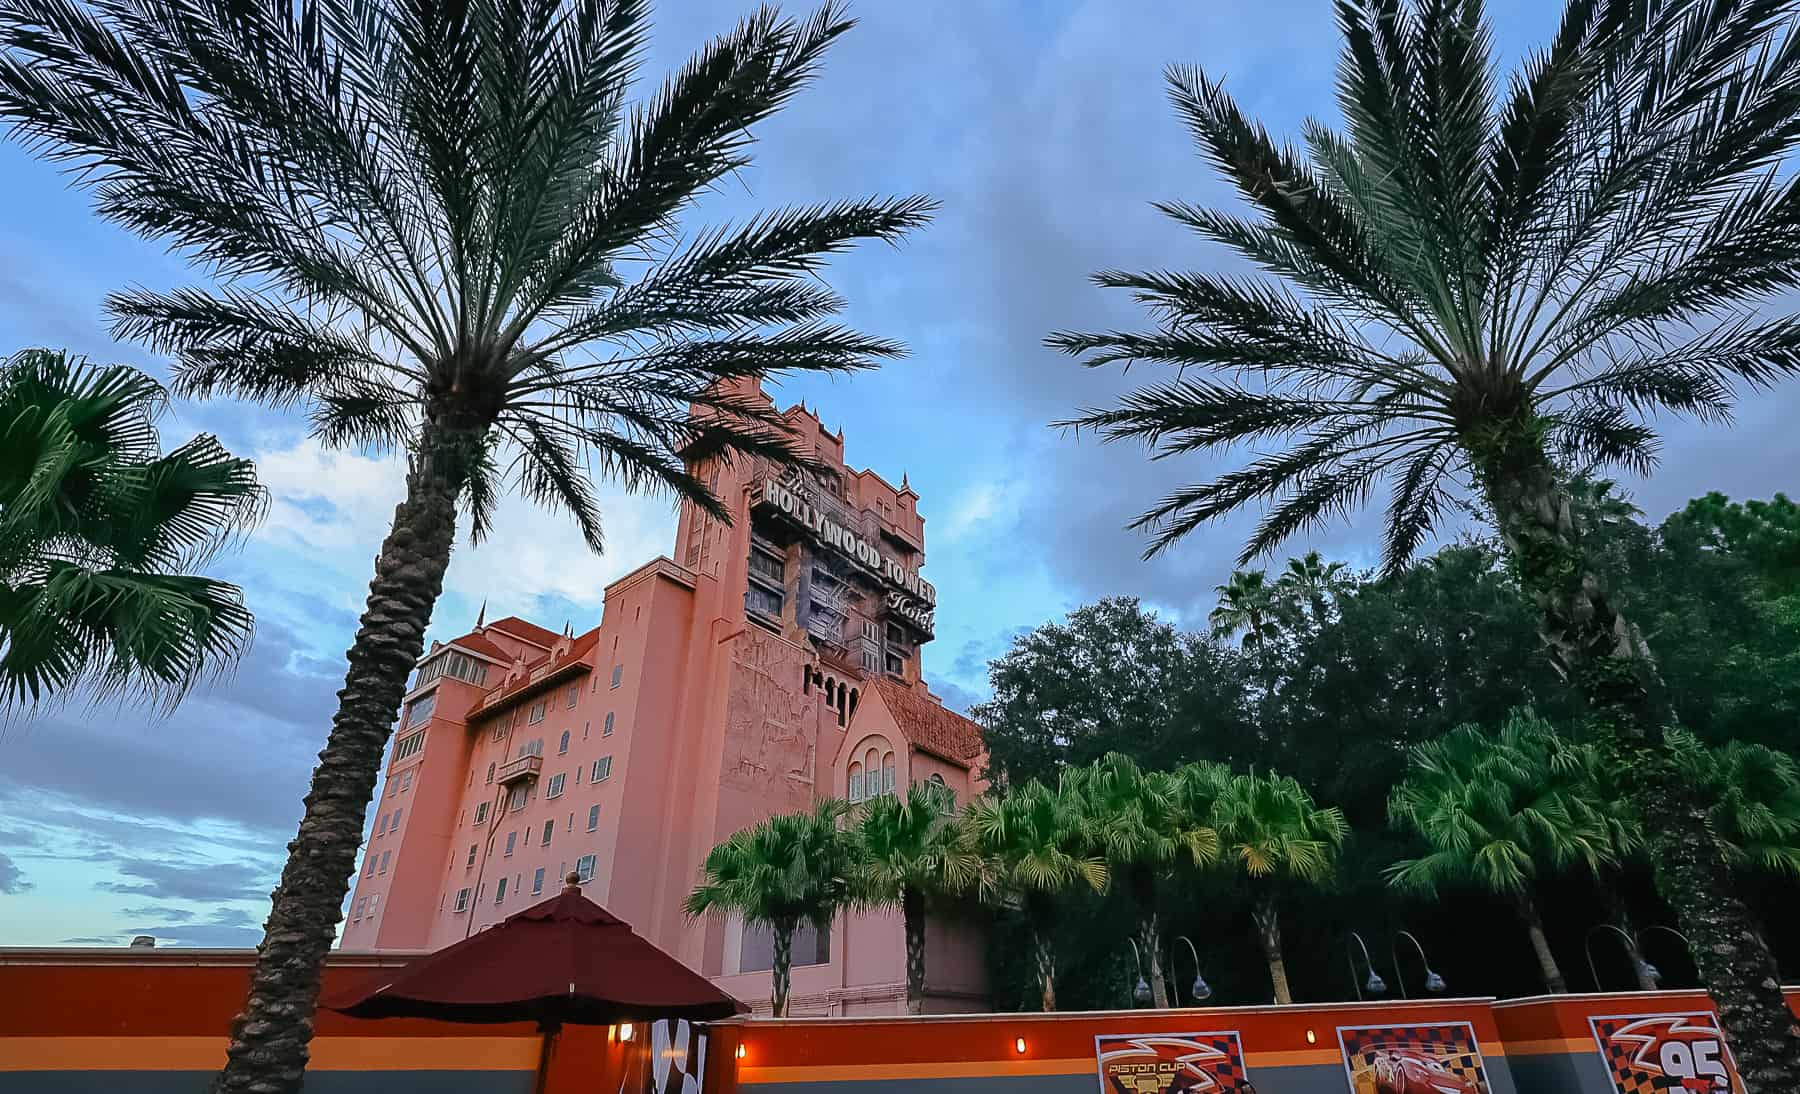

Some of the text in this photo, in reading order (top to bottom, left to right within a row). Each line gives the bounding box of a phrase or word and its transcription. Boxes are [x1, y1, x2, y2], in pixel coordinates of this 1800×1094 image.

[767, 479, 936, 607] HOLLYWOOD TOWER
[887, 590, 936, 632] Hotel
[1109, 1063, 1186, 1073] PISTON CUP
[1660, 1040, 1729, 1093] 95
